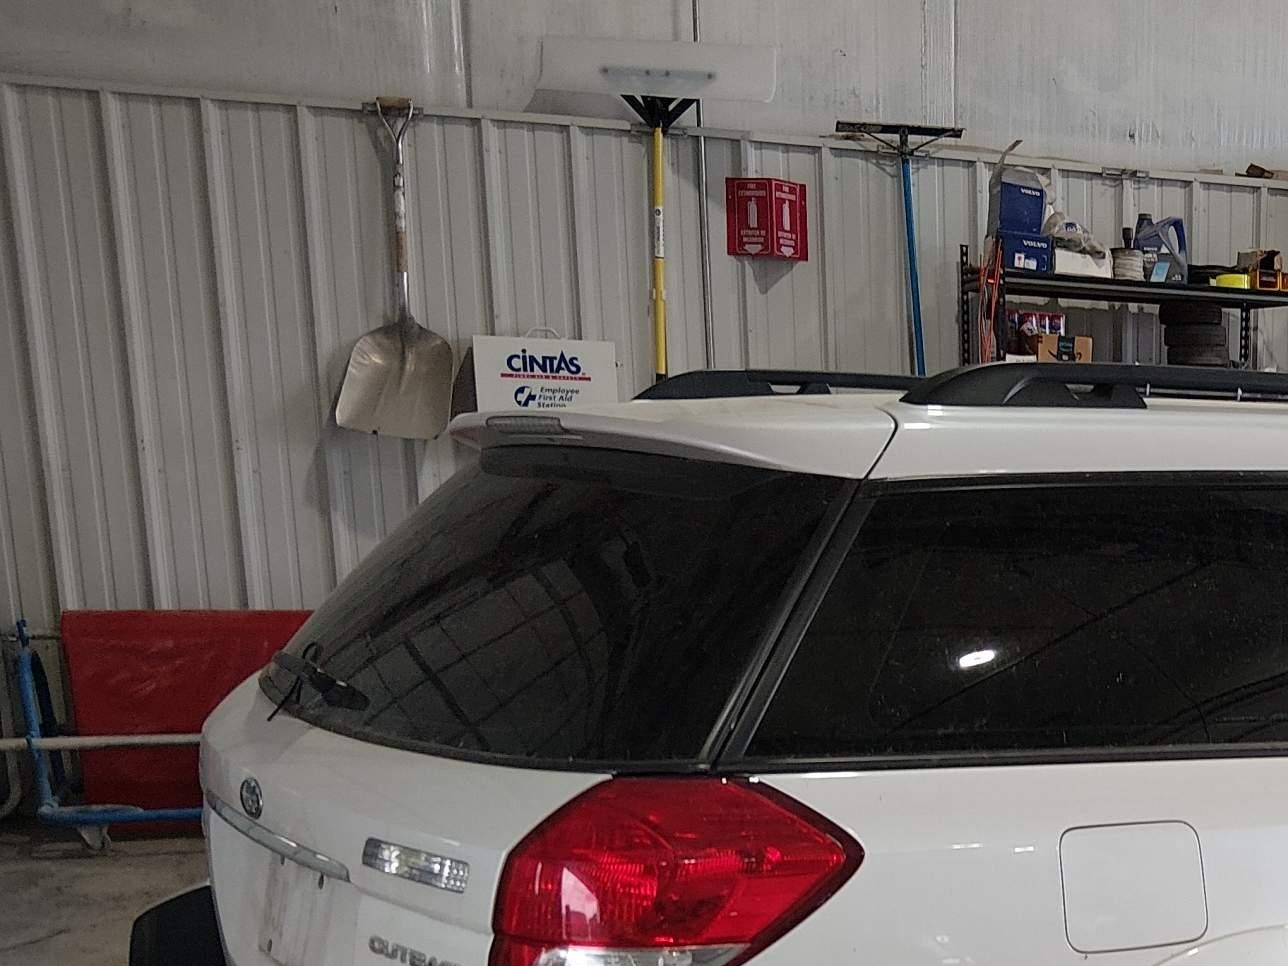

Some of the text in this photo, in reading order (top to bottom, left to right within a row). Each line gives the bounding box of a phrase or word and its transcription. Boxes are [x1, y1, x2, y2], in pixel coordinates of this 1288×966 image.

[1020, 187, 1041, 197] VOLVO
[1022, 239, 1048, 249] VOLVO
[506, 348, 582, 375] CINTAS
[540, 386, 580, 395] Employee
[537, 393, 574, 402] First Aid
[536, 401, 567, 409] Station
